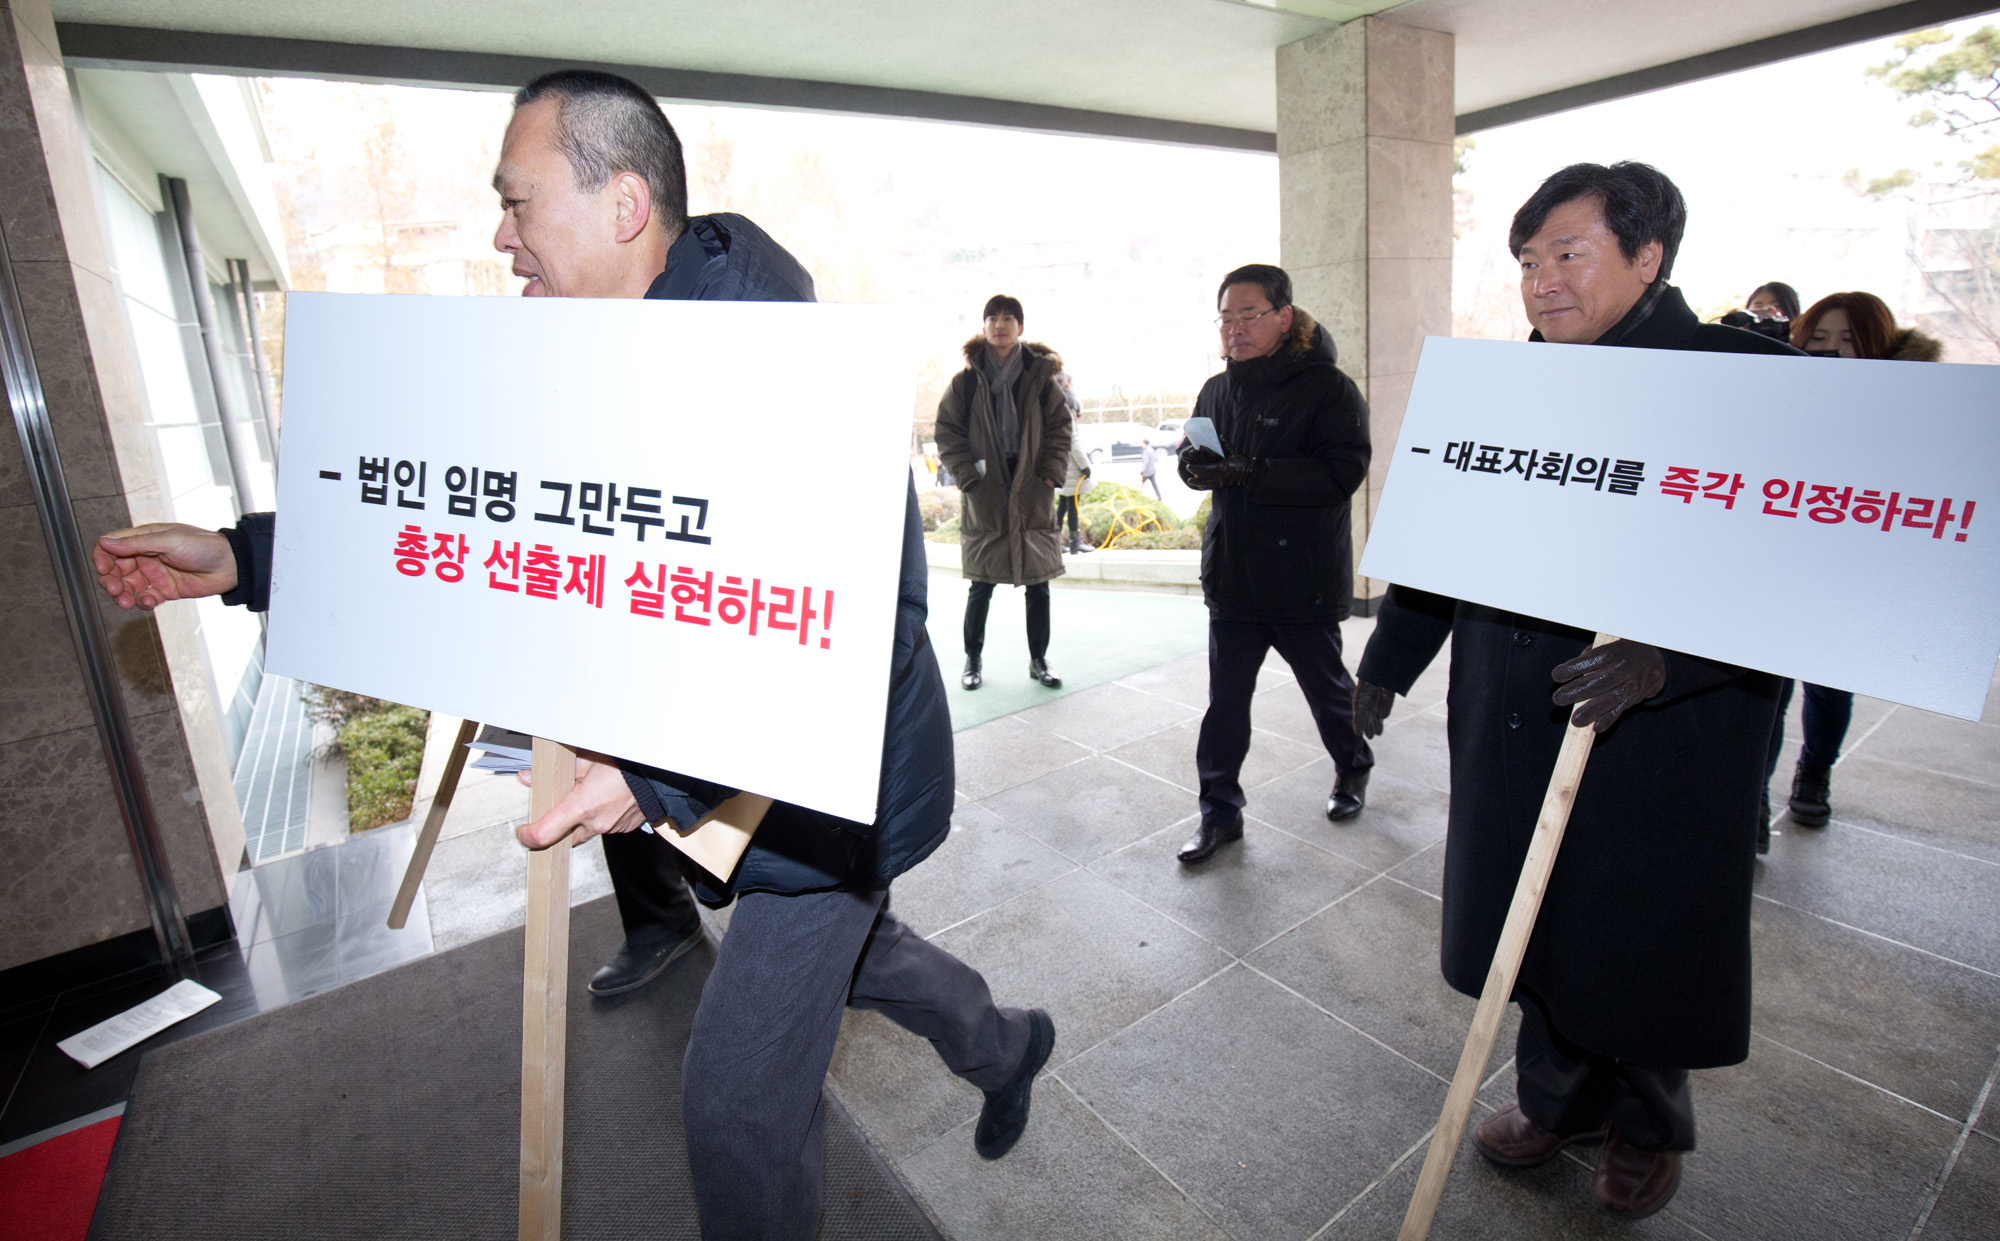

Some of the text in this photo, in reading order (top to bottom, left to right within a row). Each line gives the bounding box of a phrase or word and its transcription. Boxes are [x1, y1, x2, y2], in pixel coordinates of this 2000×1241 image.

[358, 456, 427, 510] 법인
[444, 464, 518, 523] 임명
[534, 480, 711, 545] 그만두고
[1443, 441, 1646, 496] 대표자회의를
[1659, 465, 1745, 510] 즉각
[1761, 478, 1976, 542] 인정하라!
[392, 524, 835, 650] 총장 선출제 실현하라!
